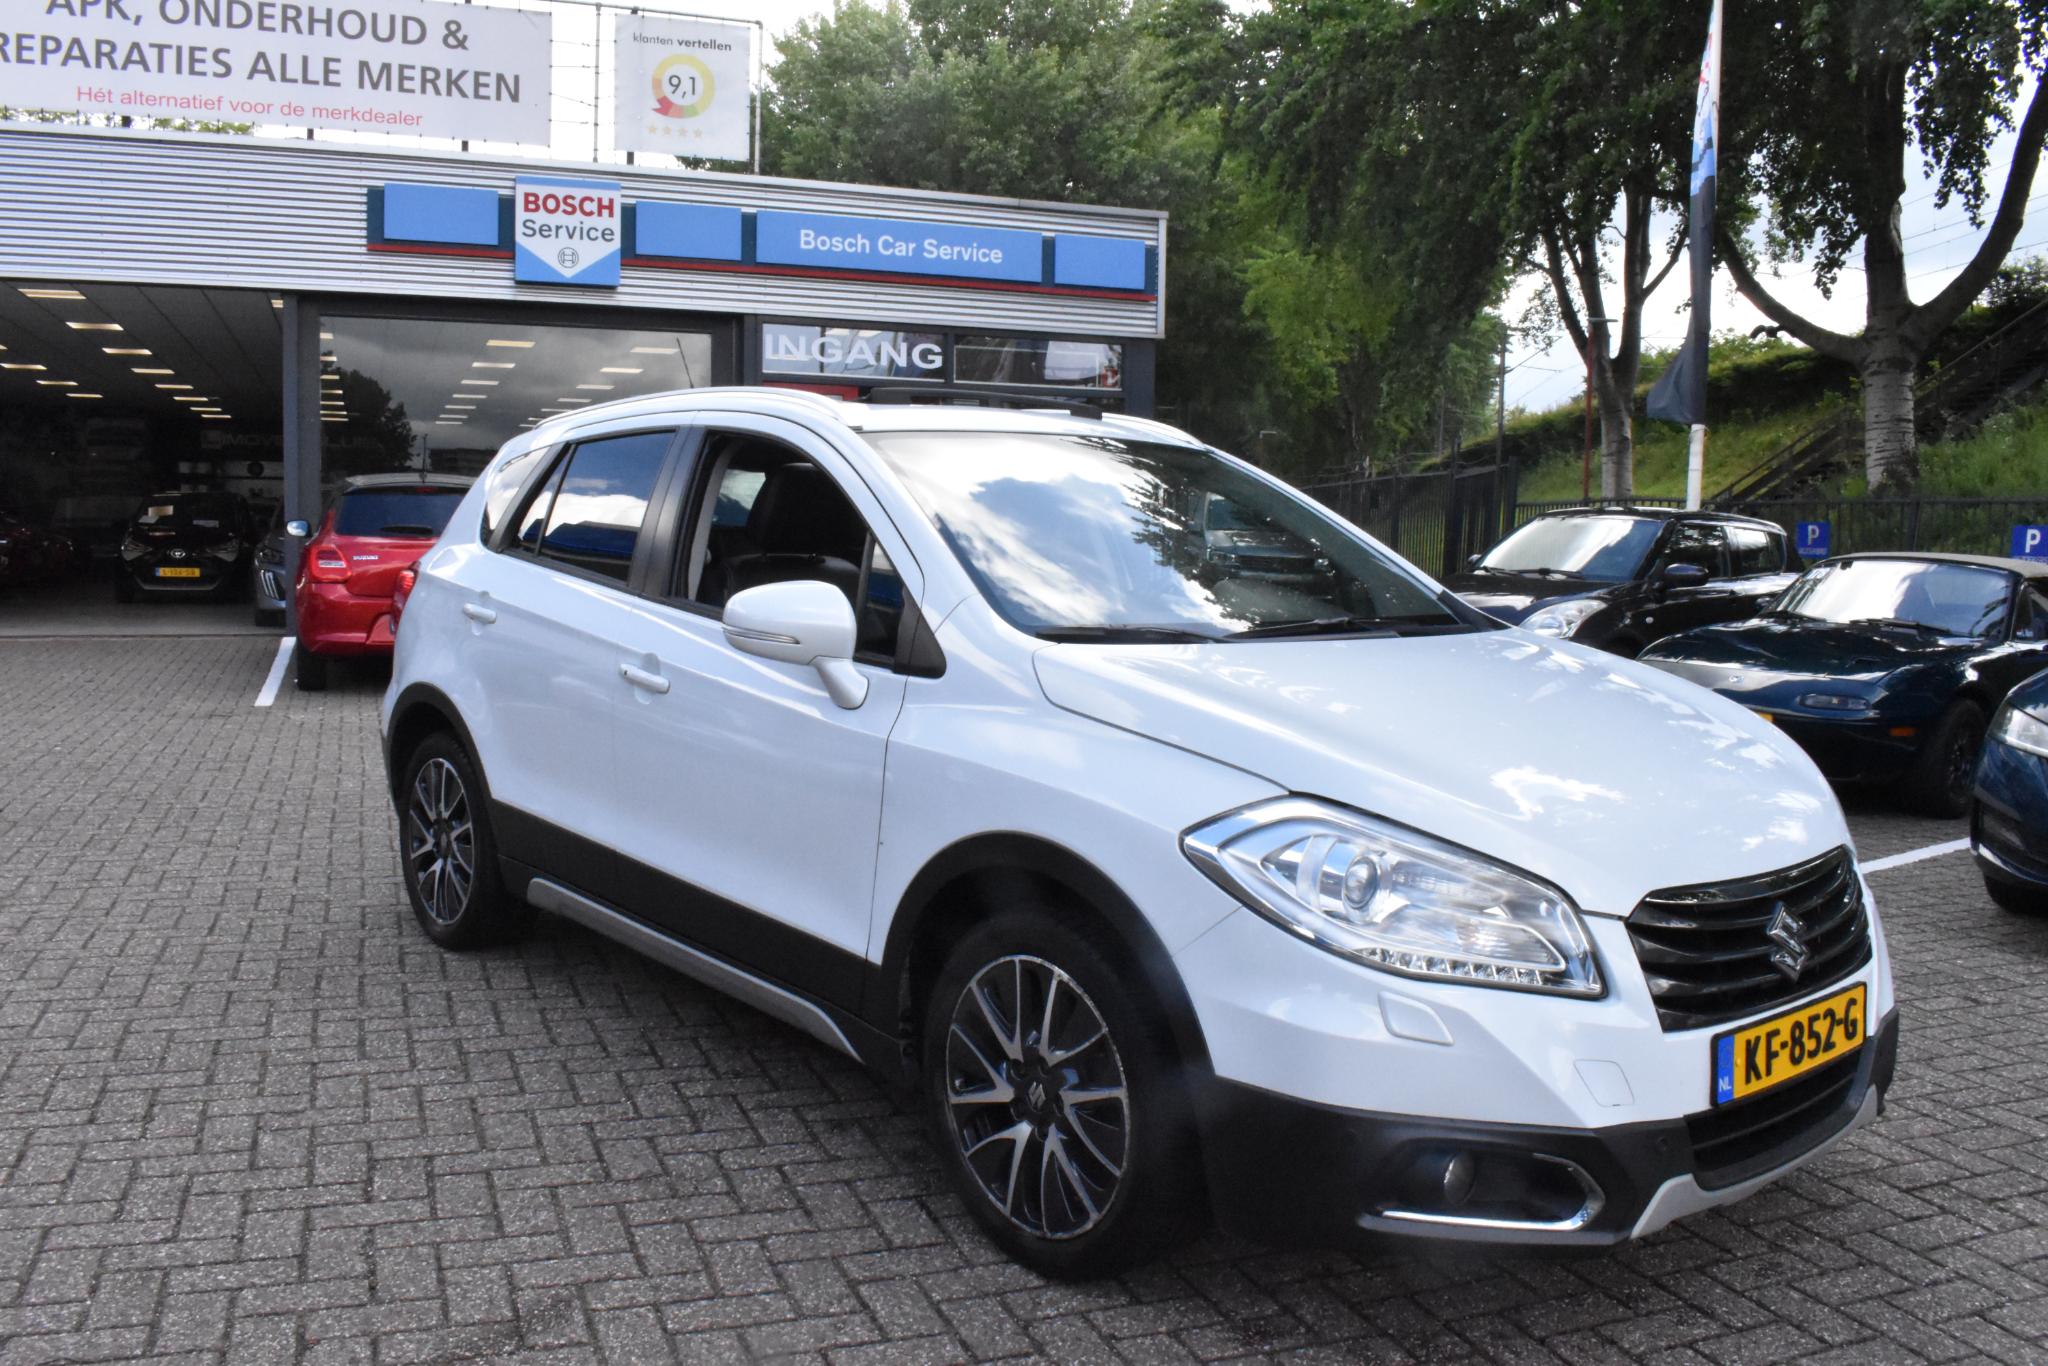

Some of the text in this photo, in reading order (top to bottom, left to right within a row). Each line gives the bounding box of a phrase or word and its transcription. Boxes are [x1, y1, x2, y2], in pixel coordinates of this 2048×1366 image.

[159, 0, 427, 45] ONDERHOUD
[442, 20, 469, 50] &
[633, 32, 732, 52] klanten vertellen
[247, 51, 342, 87] ALLE
[358, 60, 520, 103] MERKEN
[668, 74, 696, 98] 9,1
[76, 86, 423, 126] Hét alternatief voor de merkdealer
[523, 192, 615, 218] BOSCH
[522, 219, 615, 242] Service
[800, 229, 1003, 264] Bosch Car Service
[765, 333, 943, 369] INGANG
[1807, 525, 1819, 546] P
[2025, 529, 2041, 553] P
[1745, 998, 1858, 1085] KF-852-G
[1718, 1077, 1732, 1092] NL
